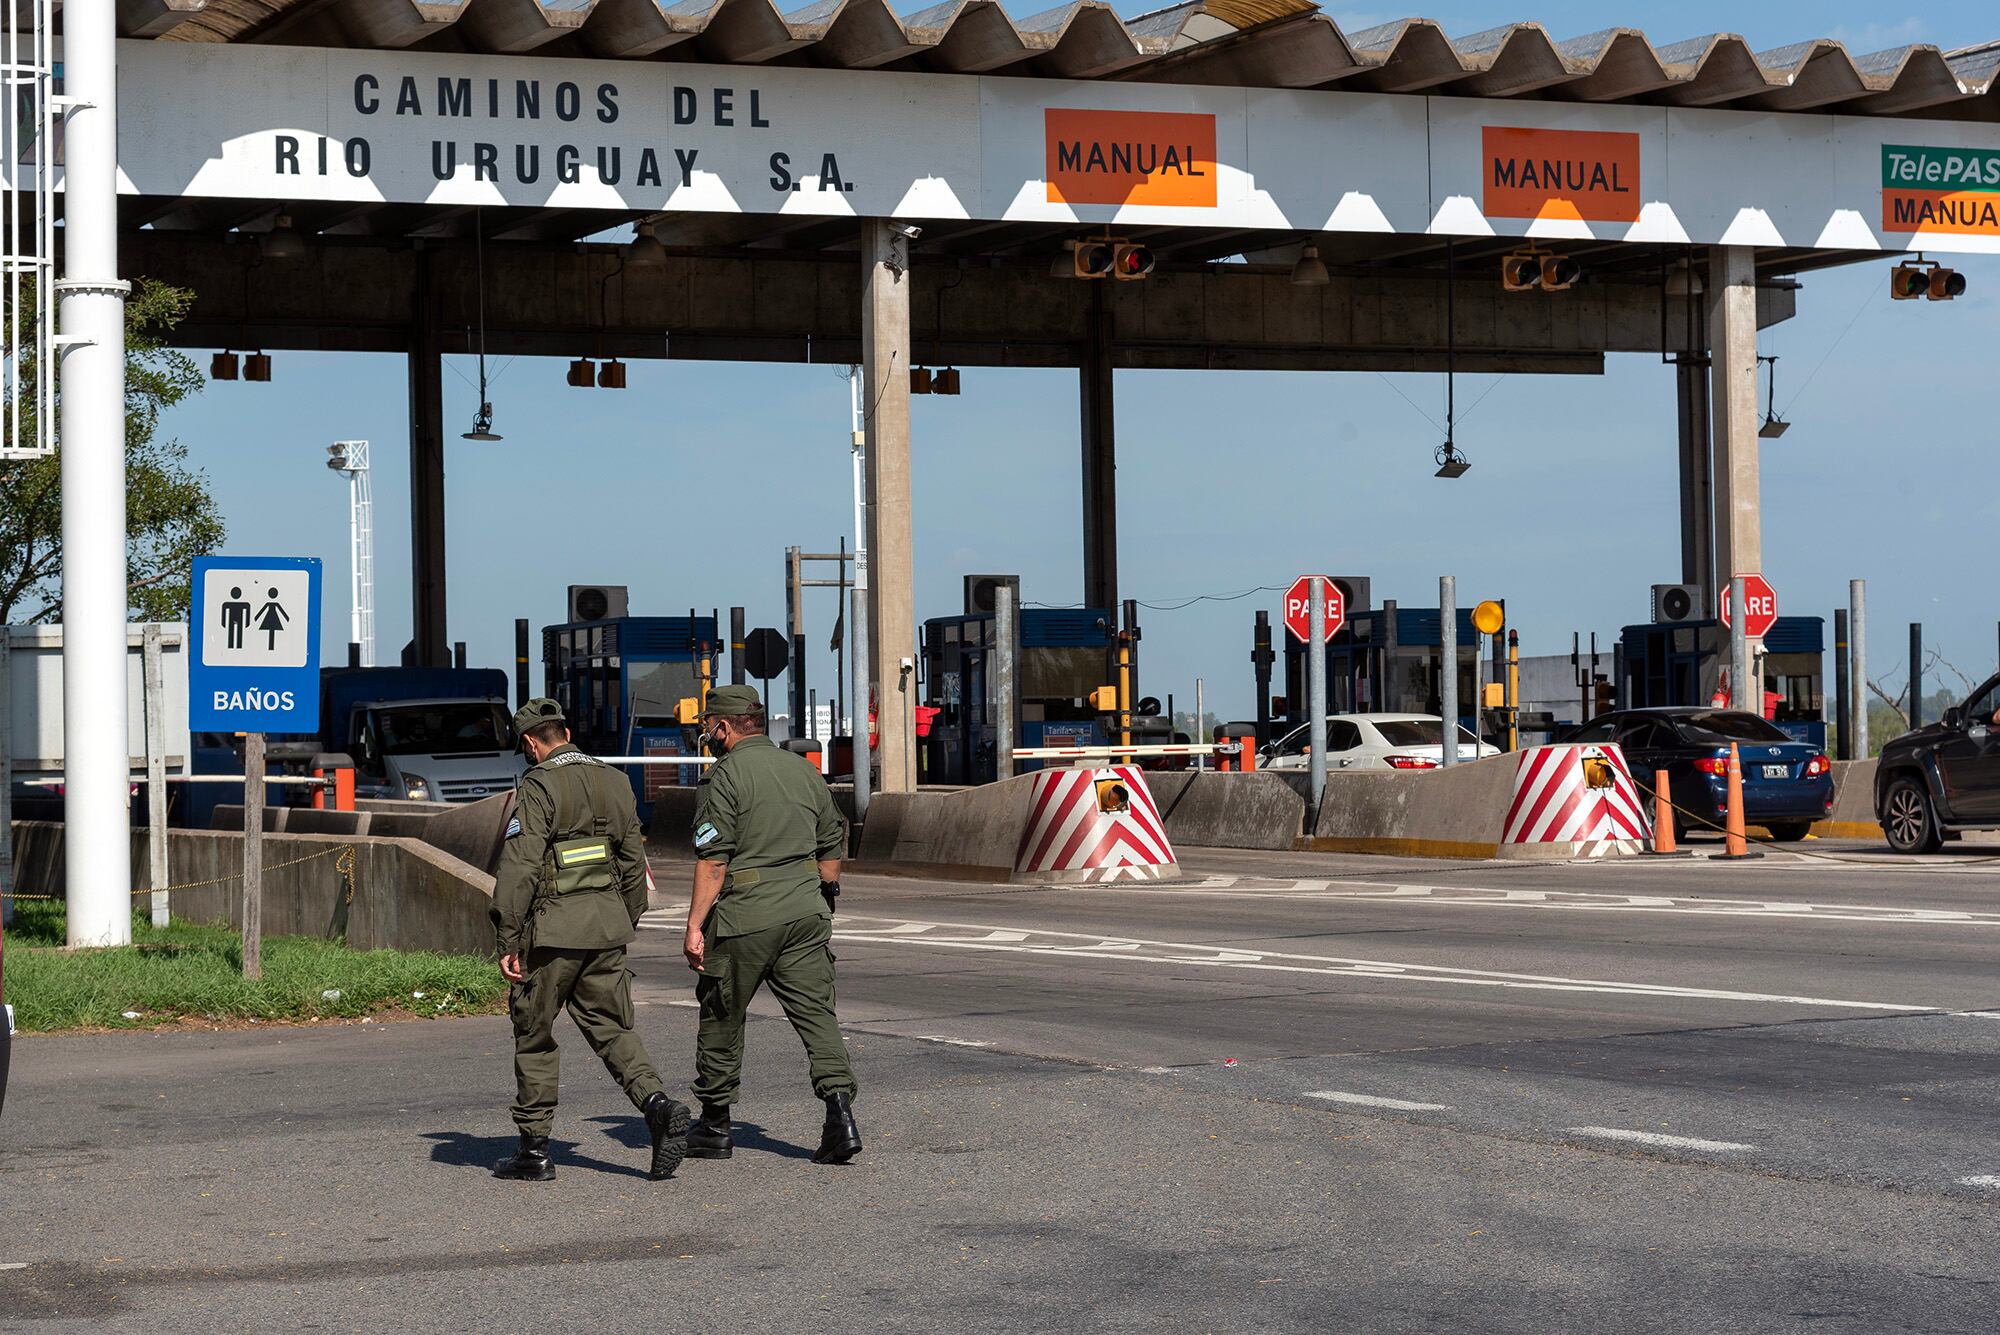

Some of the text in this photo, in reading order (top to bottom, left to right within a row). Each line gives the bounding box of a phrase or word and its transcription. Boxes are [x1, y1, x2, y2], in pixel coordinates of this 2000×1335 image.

[354, 74, 770, 128] CAMINOS DEL
[275, 135, 371, 178] RIO
[431, 140, 699, 188] URUGUAY
[1058, 140, 1205, 177] MANUAL
[1888, 153, 2000, 184] TelePAS
[1494, 157, 1629, 193] MANUAL
[1894, 198, 1999, 227] MANUA
[1289, 598, 1339, 619] PAE
[213, 687, 295, 711] BAÑOS
[649, 738, 676, 747] Tarifas
[555, 755, 597, 766] NACIONAL
